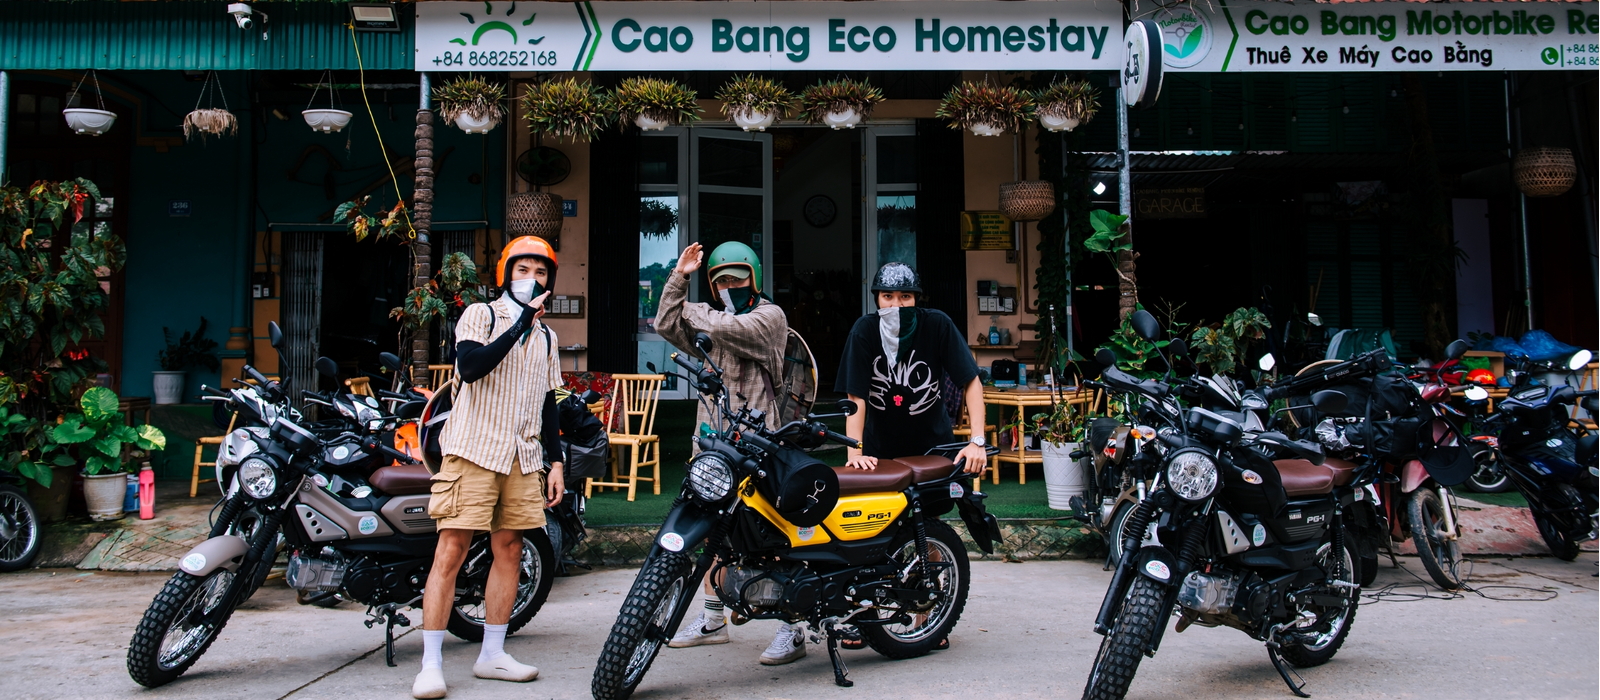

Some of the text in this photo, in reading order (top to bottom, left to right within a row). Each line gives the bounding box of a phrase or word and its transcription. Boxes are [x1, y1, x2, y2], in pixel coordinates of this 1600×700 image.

[1245, 9, 1599, 42] Cao Bang Motorbike Re
[611, 18, 1109, 62] Cao Bang Eco Homestay
[1246, 40, 1492, 67] Thuê Xe Máy Cao Bằng
[1566, 43, 1586, 53] +84
[432, 50, 557, 66] +84 868252168
[1567, 56, 1586, 66] +84
[172, 201, 189, 209] 236
[1138, 197, 1205, 214] GARAGE
[867, 511, 892, 520] PG-1
[1306, 514, 1326, 524] PG-1
